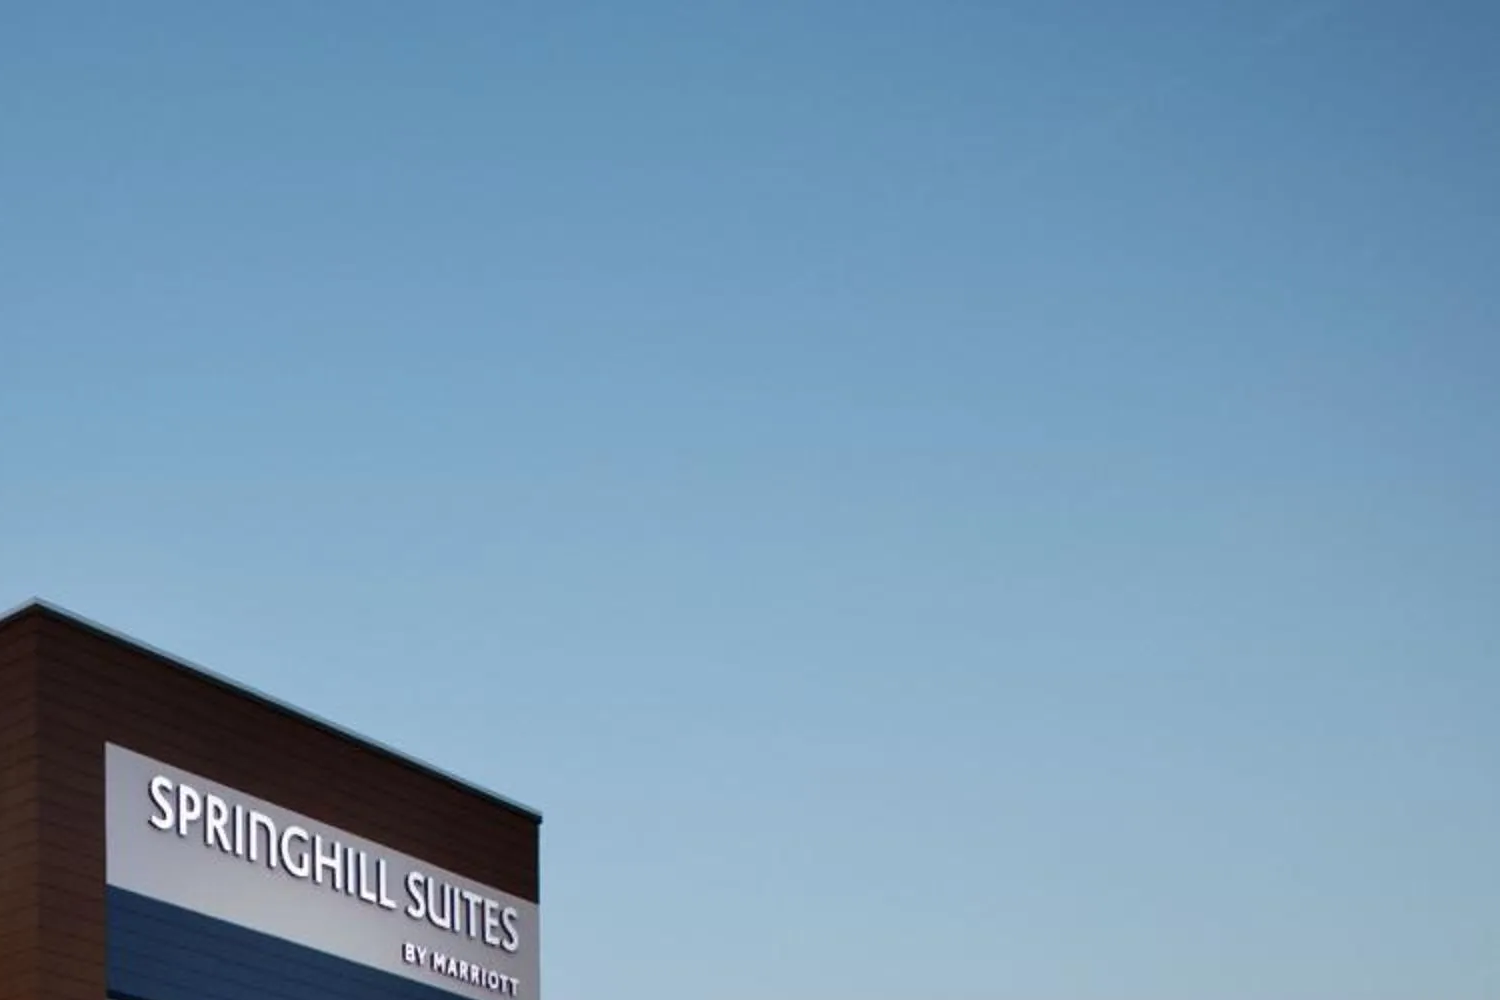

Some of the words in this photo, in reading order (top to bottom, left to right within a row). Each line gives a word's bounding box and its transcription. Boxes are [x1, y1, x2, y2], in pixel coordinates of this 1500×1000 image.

[148, 774, 397, 910] SPRINGHILL
[405, 871, 520, 952] SUITES
[404, 943, 427, 965] BY
[432, 951, 520, 997] MARRIOTT
